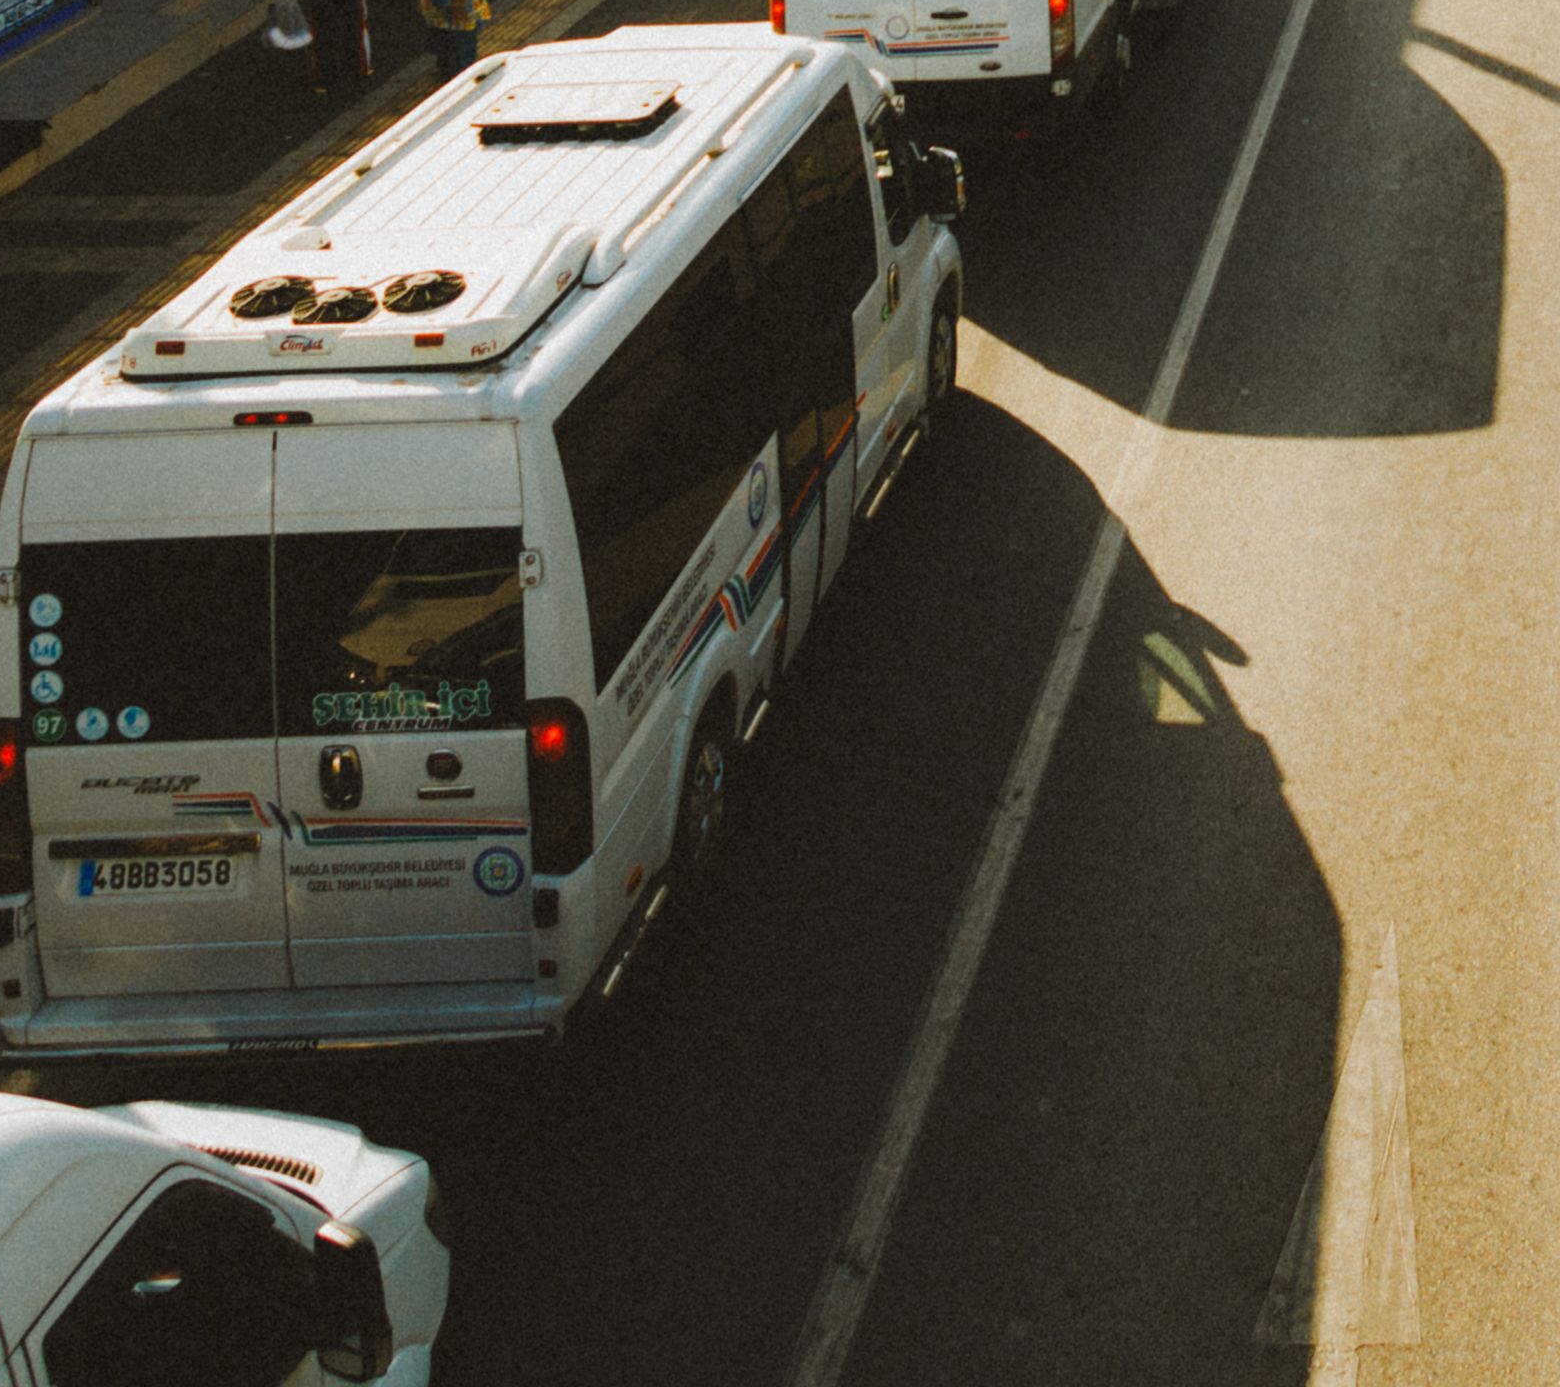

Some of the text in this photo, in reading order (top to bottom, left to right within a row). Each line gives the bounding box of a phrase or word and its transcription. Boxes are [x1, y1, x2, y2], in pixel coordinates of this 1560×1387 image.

[312, 678, 492, 726] ŞEHİR İÇİ
[36, 716, 63, 735] 97
[351, 716, 453, 732] CENTRUM
[92, 858, 232, 890] 48BB3058
[289, 857, 466, 877] MUĞLA BÜYÜKŞEHİR BELEDİYESİ
[307, 877, 451, 893] ÖZEL TOPLU TAŞIMA ARACI
